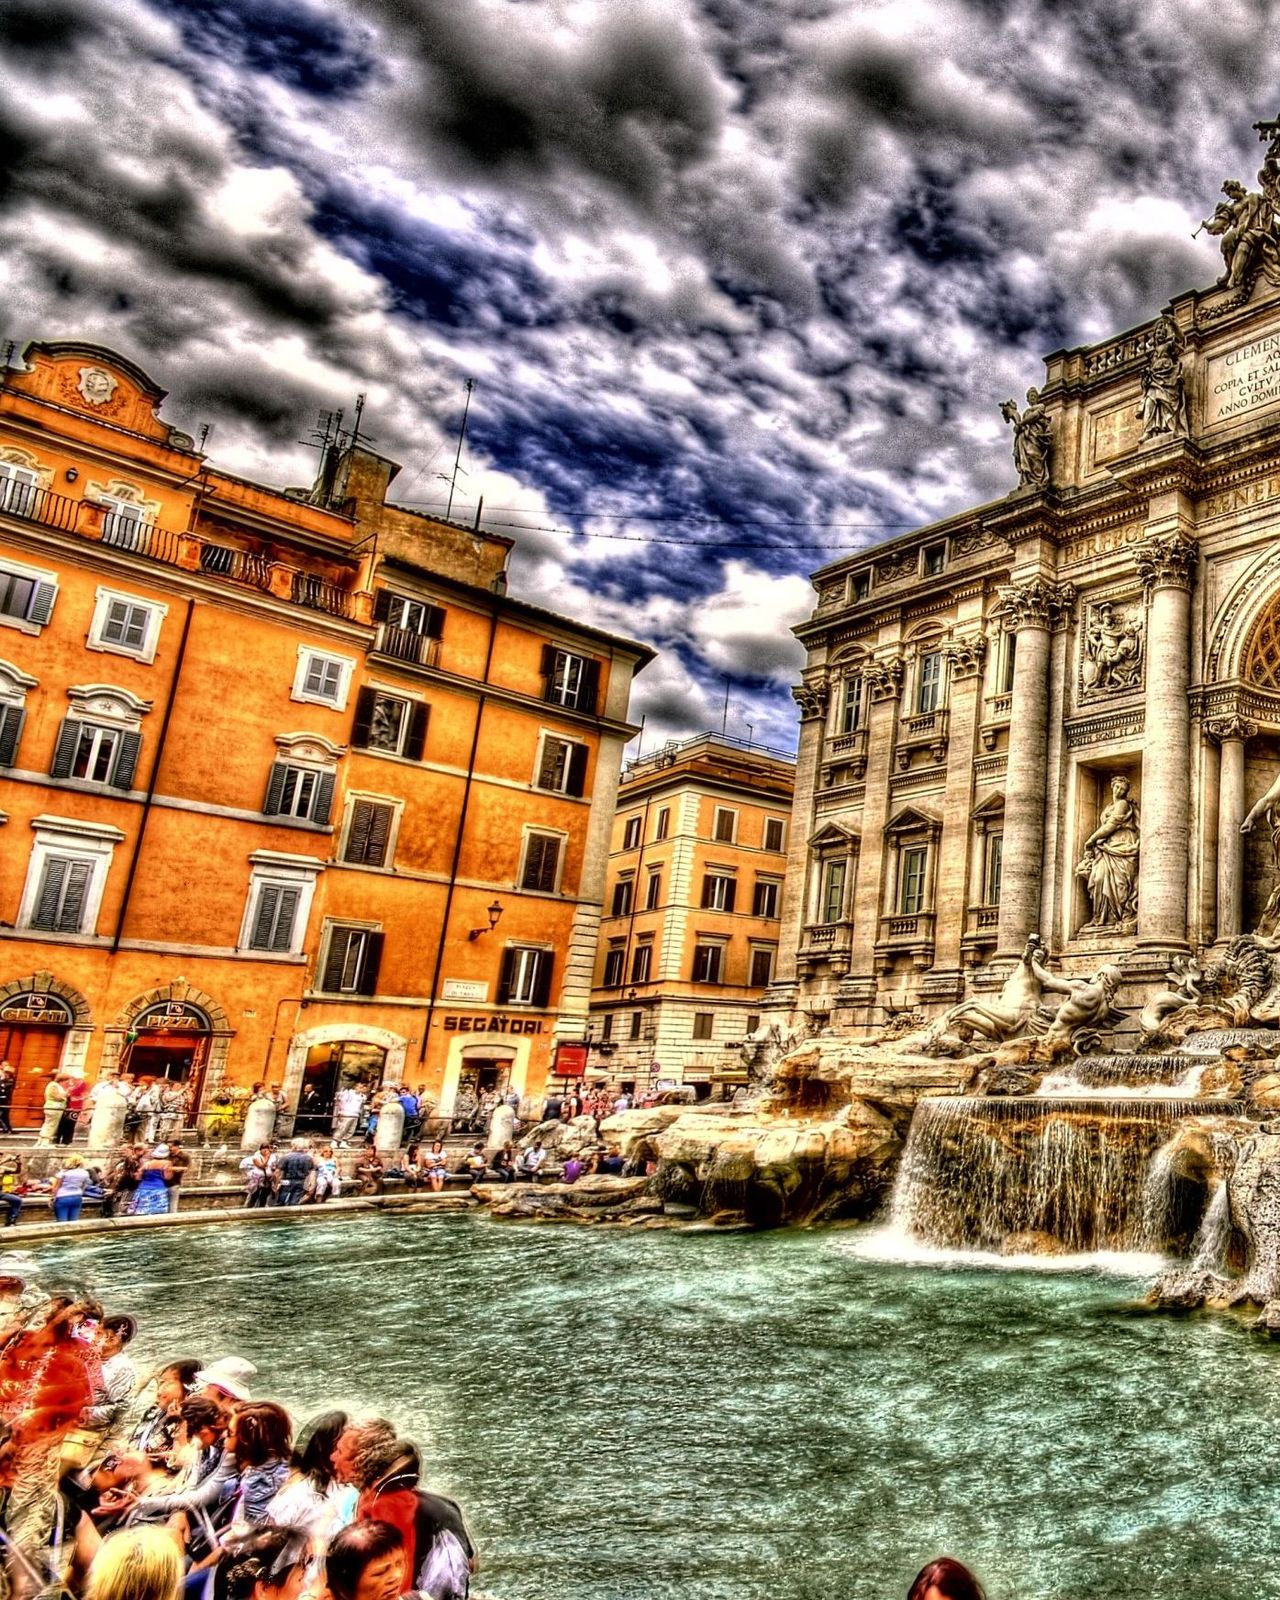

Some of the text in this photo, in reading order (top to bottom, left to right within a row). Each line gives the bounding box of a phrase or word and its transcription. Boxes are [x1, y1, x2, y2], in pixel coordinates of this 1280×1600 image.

[1214, 377, 1244, 395] COPIA
[1248, 370, 1260, 382] ET
[1239, 376, 1273, 396] CVLTV
[1217, 398, 1248, 417] ANNO
[1, 1007, 67, 1023] GELATI
[148, 1015, 199, 1028] PIZZA
[443, 1016, 542, 1035] SEGATORI
